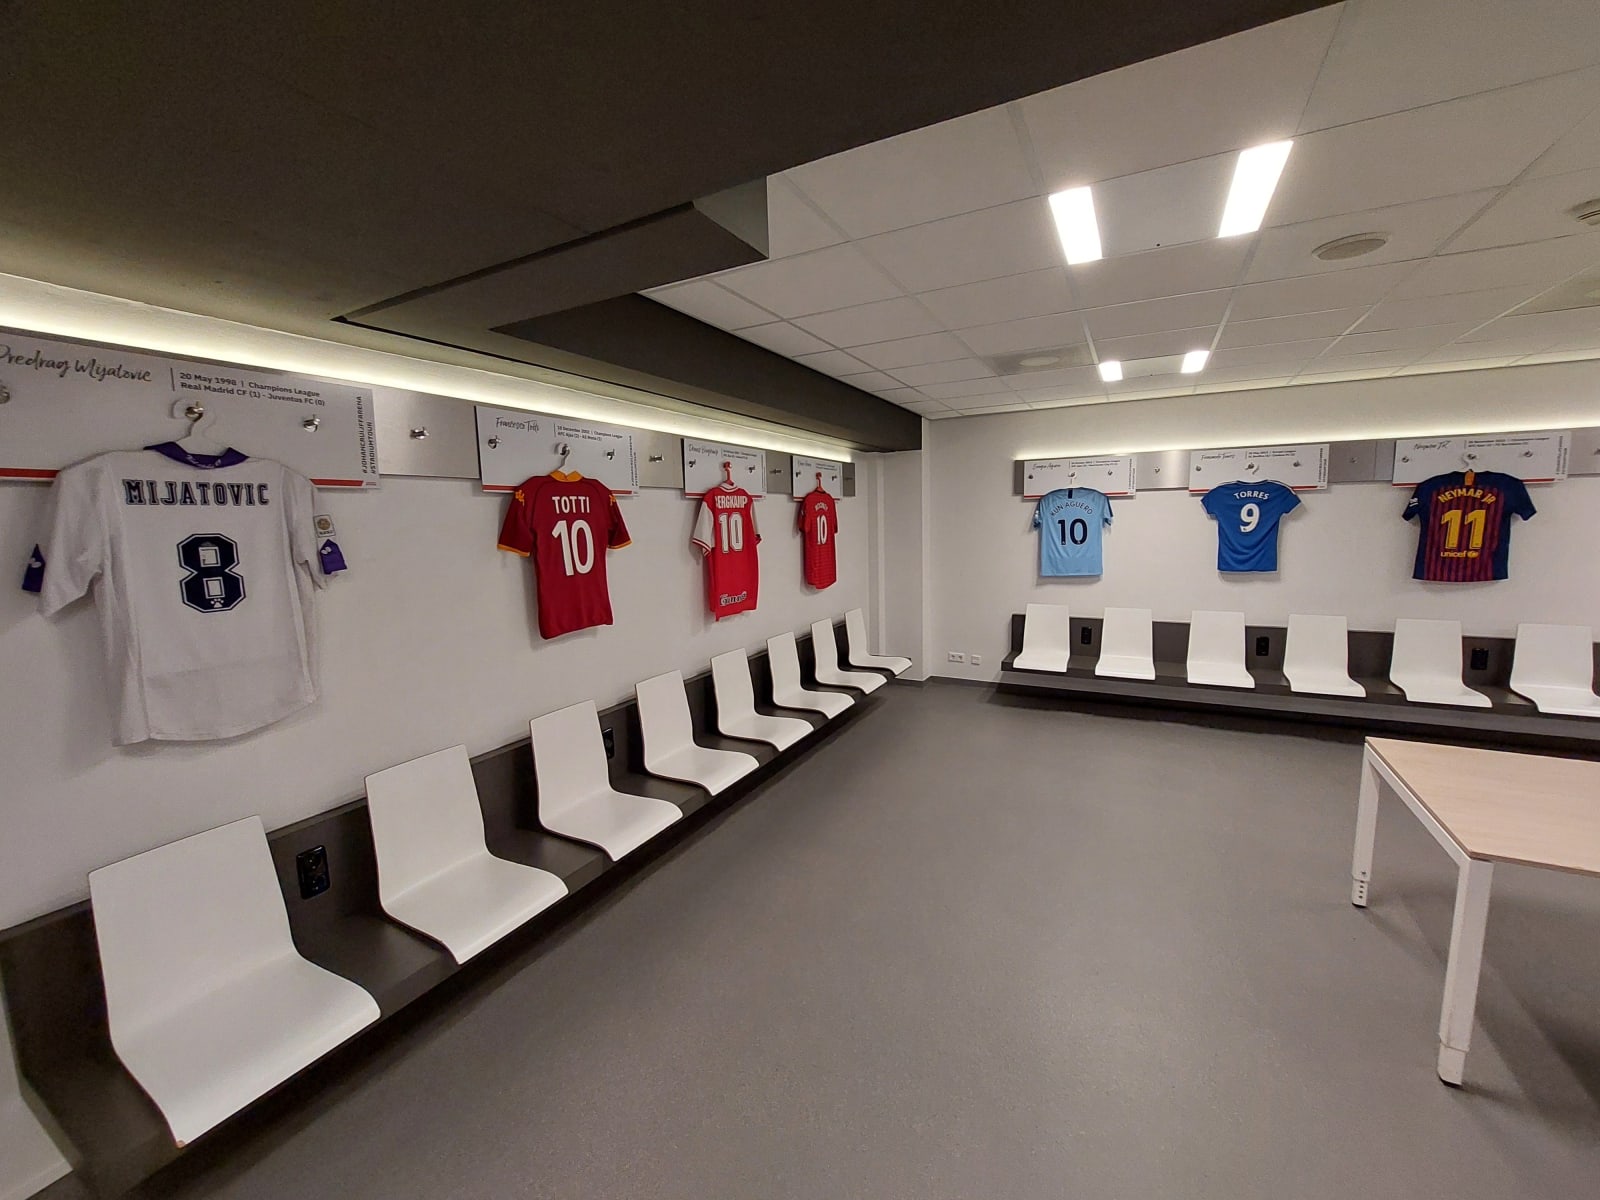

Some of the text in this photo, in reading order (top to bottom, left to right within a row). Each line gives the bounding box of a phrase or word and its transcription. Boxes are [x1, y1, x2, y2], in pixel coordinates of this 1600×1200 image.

[179, 372, 192, 380] 20
[194, 374, 212, 384] May
[215, 377, 237, 386] 1998
[248, 381, 293, 395] Champions
[294, 388, 320, 398] League
[181, 382, 201, 391] Real
[203, 384, 234, 396] Madrid
[249, 389, 261, 400] (1)
[267, 394, 303, 404] Juventus
[304, 397, 314, 405] FC
[122, 479, 269, 506] MIJATOVIC
[552, 496, 590, 514] TOTTI
[1233, 490, 1270, 501] TORRES
[1438, 488, 1483, 503] NEYMAR
[816, 514, 828, 545] 10
[1240, 503, 1260, 533] 9
[1441, 509, 1486, 549] 11
[718, 512, 743, 553] 10
[1057, 518, 1088, 546] 10
[551, 519, 594, 576] 10
[1440, 550, 1467, 558] unicef
[176, 533, 247, 614] 8
